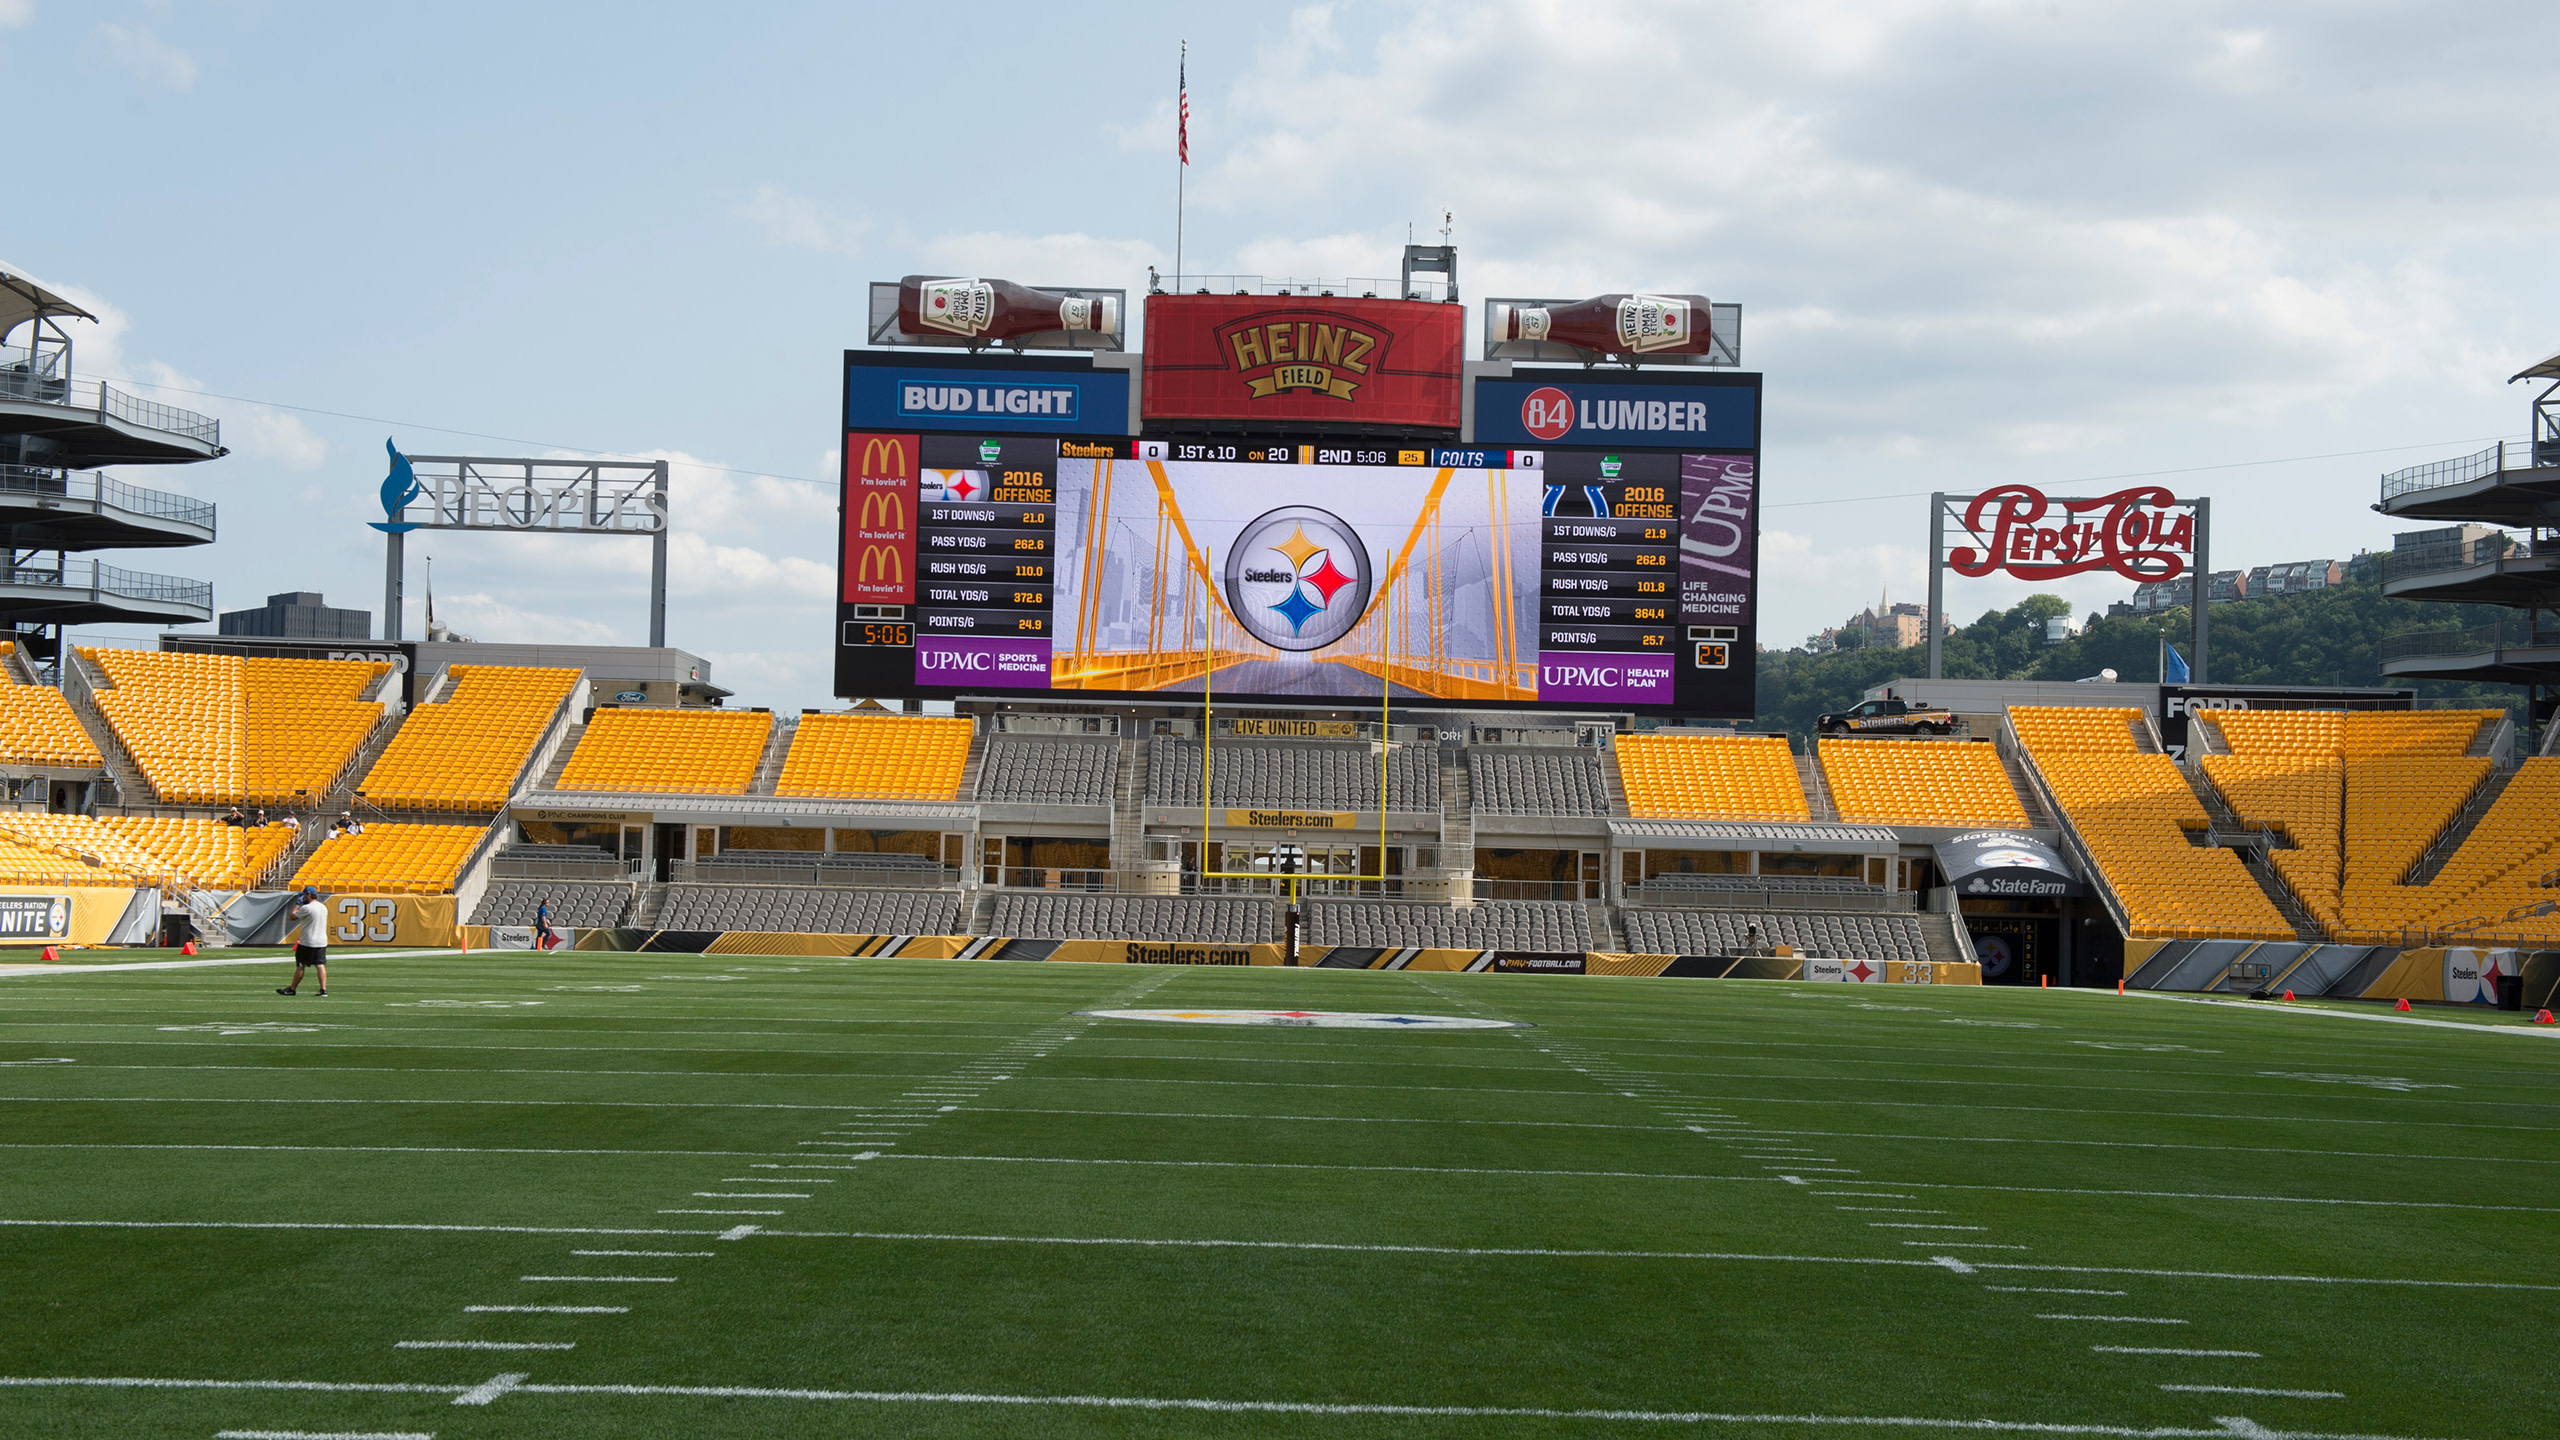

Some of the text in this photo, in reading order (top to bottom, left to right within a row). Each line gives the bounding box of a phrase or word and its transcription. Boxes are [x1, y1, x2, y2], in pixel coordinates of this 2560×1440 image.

[960, 288, 970, 322] TOMATO
[973, 289, 986, 320] HEINZ
[1071, 304, 1080, 318] 57
[1531, 316, 1540, 329] 57
[1625, 305, 1638, 337] HEINZ
[1641, 304, 1650, 338] TOMATO
[1229, 321, 1377, 375] HEINZ
[1282, 368, 1324, 386] FIELD
[904, 386, 1072, 414] BUD LIGHT
[1528, 398, 1707, 432] 84 LUMBER
[1062, 441, 1114, 458] Steelers
[1148, 446, 1158, 457] 0
[1178, 445, 1288, 461] 1ST & 10 ON 20
[1319, 449, 1387, 464] 2ND 5:06
[1404, 453, 1418, 462] 25
[1440, 451, 1485, 467] COLTS
[1523, 455, 1534, 467] 0
[861, 477, 907, 487] i'm lovin' it
[921, 481, 943, 490] teelers
[1003, 471, 1043, 487] 2016
[994, 487, 1052, 503] OFFENSE
[1624, 487, 1665, 502] 2016
[429, 476, 669, 533] PEOPLES
[1615, 503, 1674, 518] OFFENSE
[1680, 463, 1754, 557] UPMC
[932, 509, 995, 522] 1ST DOWNS/G
[1023, 512, 1045, 523] 21.0
[859, 530, 905, 540] i'm lovin' it
[1553, 525, 1617, 538] 1ST DOWNS/G
[1645, 528, 1666, 539] 21.9
[931, 535, 986, 548] PASS YDS/G
[1014, 539, 1044, 550] 262.6
[1553, 552, 1608, 564] PASS YDS/G
[1636, 554, 1666, 566] 262.6
[930, 562, 986, 575] RUSH YDS/G
[1015, 565, 1043, 576] 110.0
[1244, 568, 1292, 583] Steelers
[858, 583, 904, 593] i'm lovin' it
[1552, 579, 1608, 591] RUSH YDS/G
[1637, 581, 1665, 592] 101.8
[1682, 581, 1708, 591] LIFE
[930, 589, 989, 602] TOTAL YDS/G
[1014, 592, 1043, 604] 372.6
[1682, 592, 1746, 604] CHANGING
[1552, 605, 1611, 618] TOTAL YDS/G
[1635, 608, 1665, 619] 364.4
[1682, 604, 1740, 614] MEDICINE
[929, 616, 975, 628] POINTS/G
[1018, 619, 1042, 630] 24.9
[865, 625, 907, 644] 5:06
[1551, 632, 1597, 644] POINTS/G
[1642, 635, 1664, 646] 25.7
[921, 651, 990, 671] UPMC
[998, 653, 1038, 663] SPORTS
[1699, 646, 1725, 665] 25
[998, 663, 1047, 672] MEDICINE
[1627, 668, 1669, 678] HEALTH
[1543, 666, 1618, 687] UPMC
[1627, 678, 1656, 688] PLAN
[1235, 719, 1317, 736] LIVE UNITED
[1860, 716, 1905, 728] Steelers
[548, 811, 566, 819] PNC
[1249, 810, 1334, 828] Steelers.com
[23, 902, 48, 910] NATION
[337, 898, 397, 943] 33
[501, 933, 530, 942] Steelers
[1126, 942, 1250, 966] Steelers.com
[1814, 965, 1842, 974] Steelers
[1903, 962, 1933, 985] 33
[2452, 967, 2478, 980] Steelers
